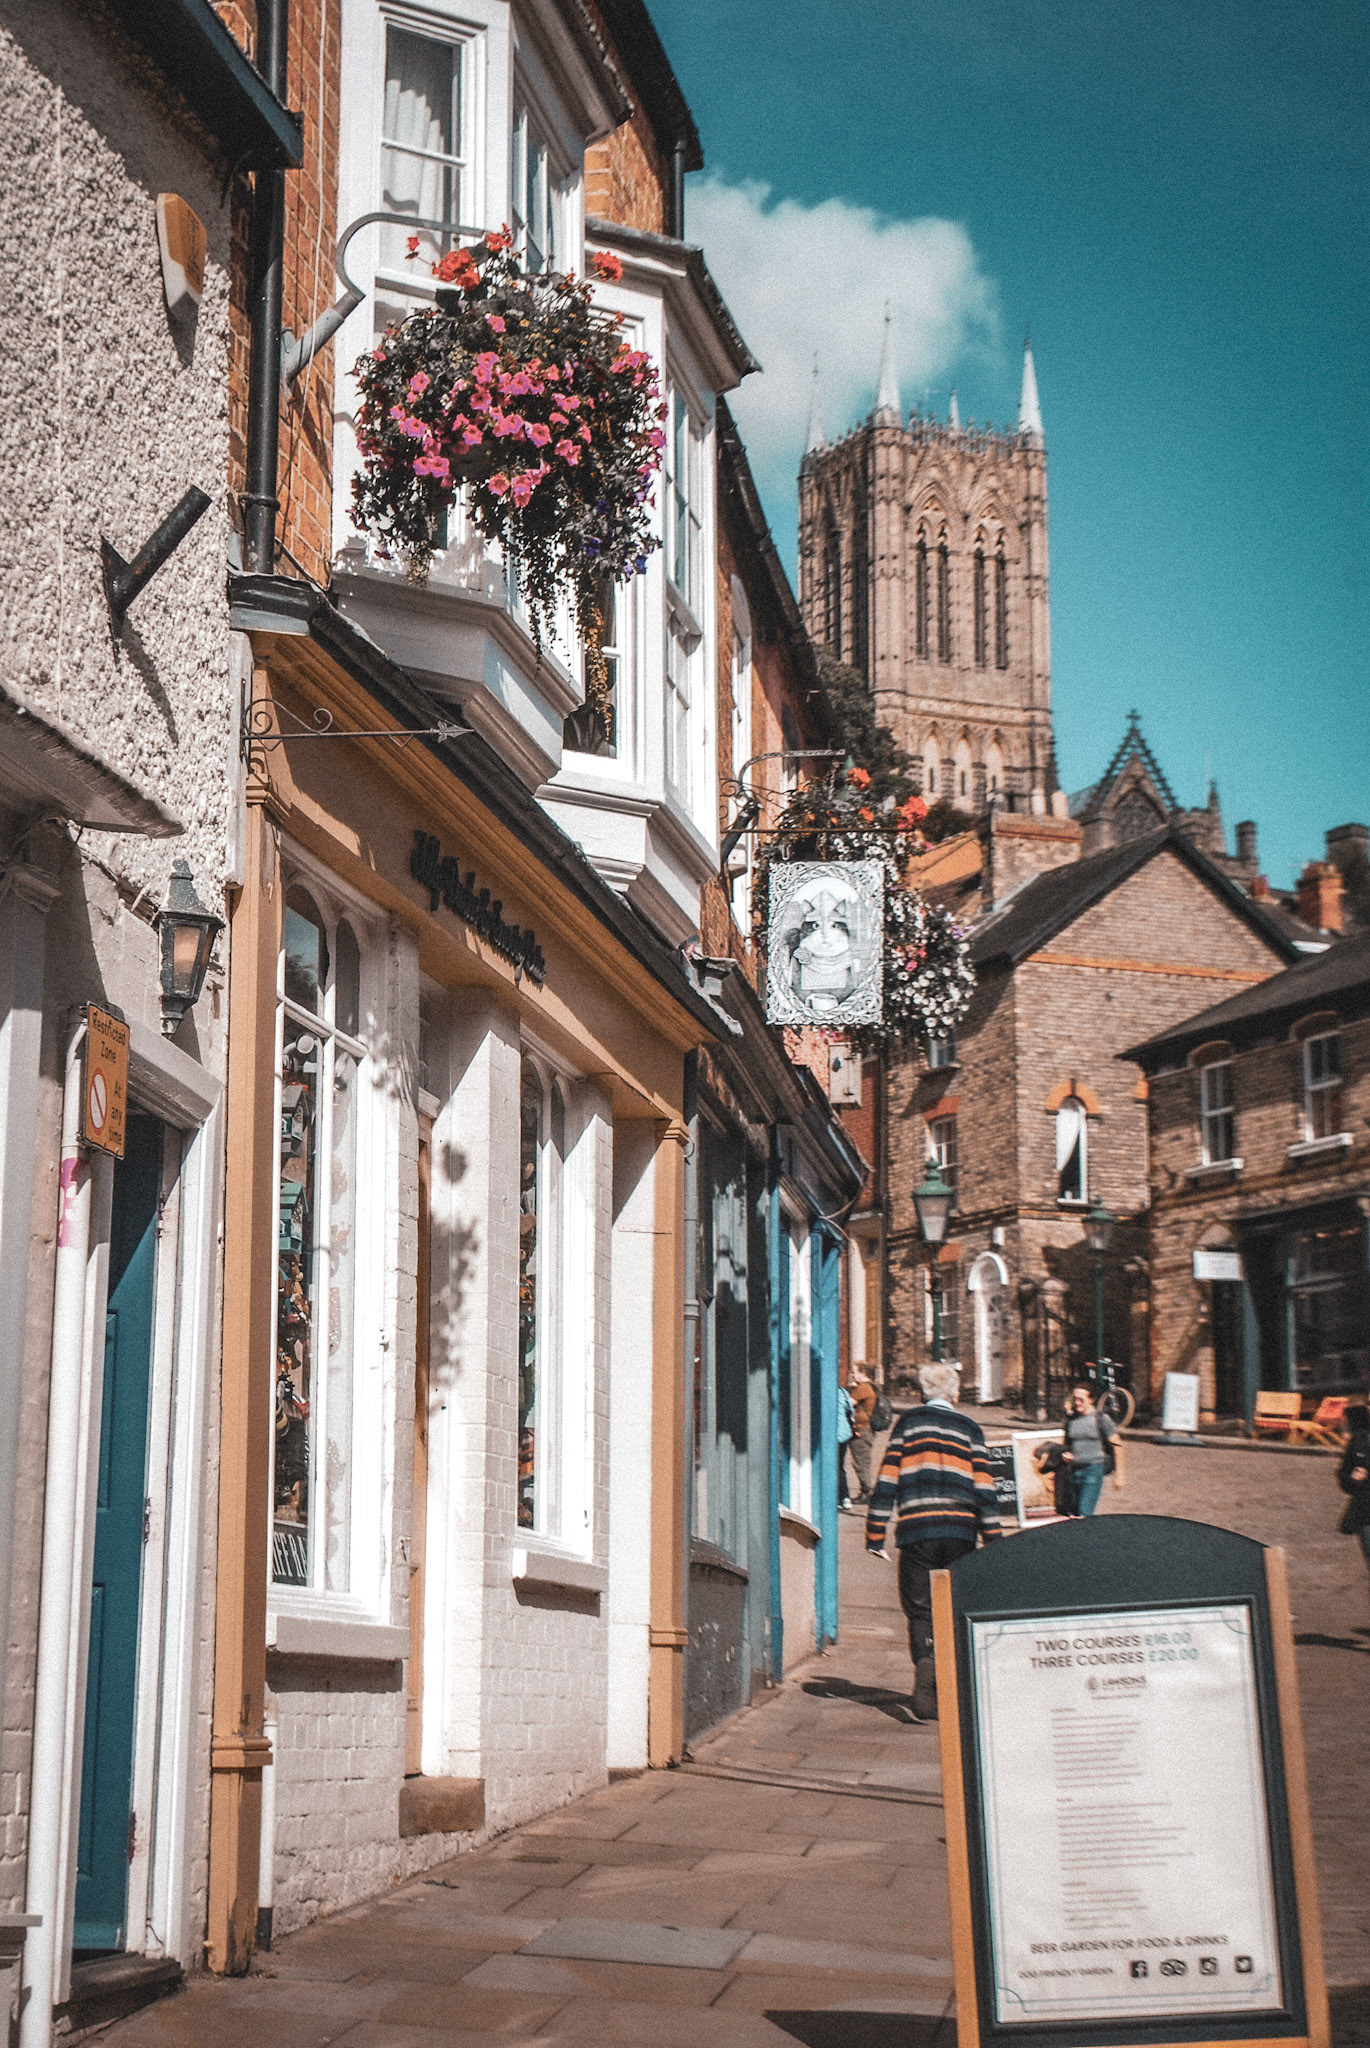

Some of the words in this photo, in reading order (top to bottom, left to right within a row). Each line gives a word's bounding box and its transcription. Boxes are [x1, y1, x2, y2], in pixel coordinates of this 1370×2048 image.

[92, 1010, 126, 1046] Restricted
[101, 1040, 116, 1064] Zone
[114, 1080, 122, 1099] At
[111, 1106, 122, 1125] any
[109, 1126, 122, 1146] time
[1034, 1639, 1070, 1651] TWO
[1072, 1635, 1142, 1650] COURSES
[1145, 1632, 1192, 1646] £16.00
[1030, 1655, 1073, 1668] THREE
[1076, 1651, 1145, 1666] COURSES
[1149, 1648, 1200, 1662] £20.00
[1060, 1940, 1109, 1952] GARDEN
[1111, 1938, 1135, 1950] FOR
[1136, 1937, 1171, 1949] FOOD
[1173, 1936, 1184, 1947] &
[1185, 1934, 1229, 1947] DRINKS
